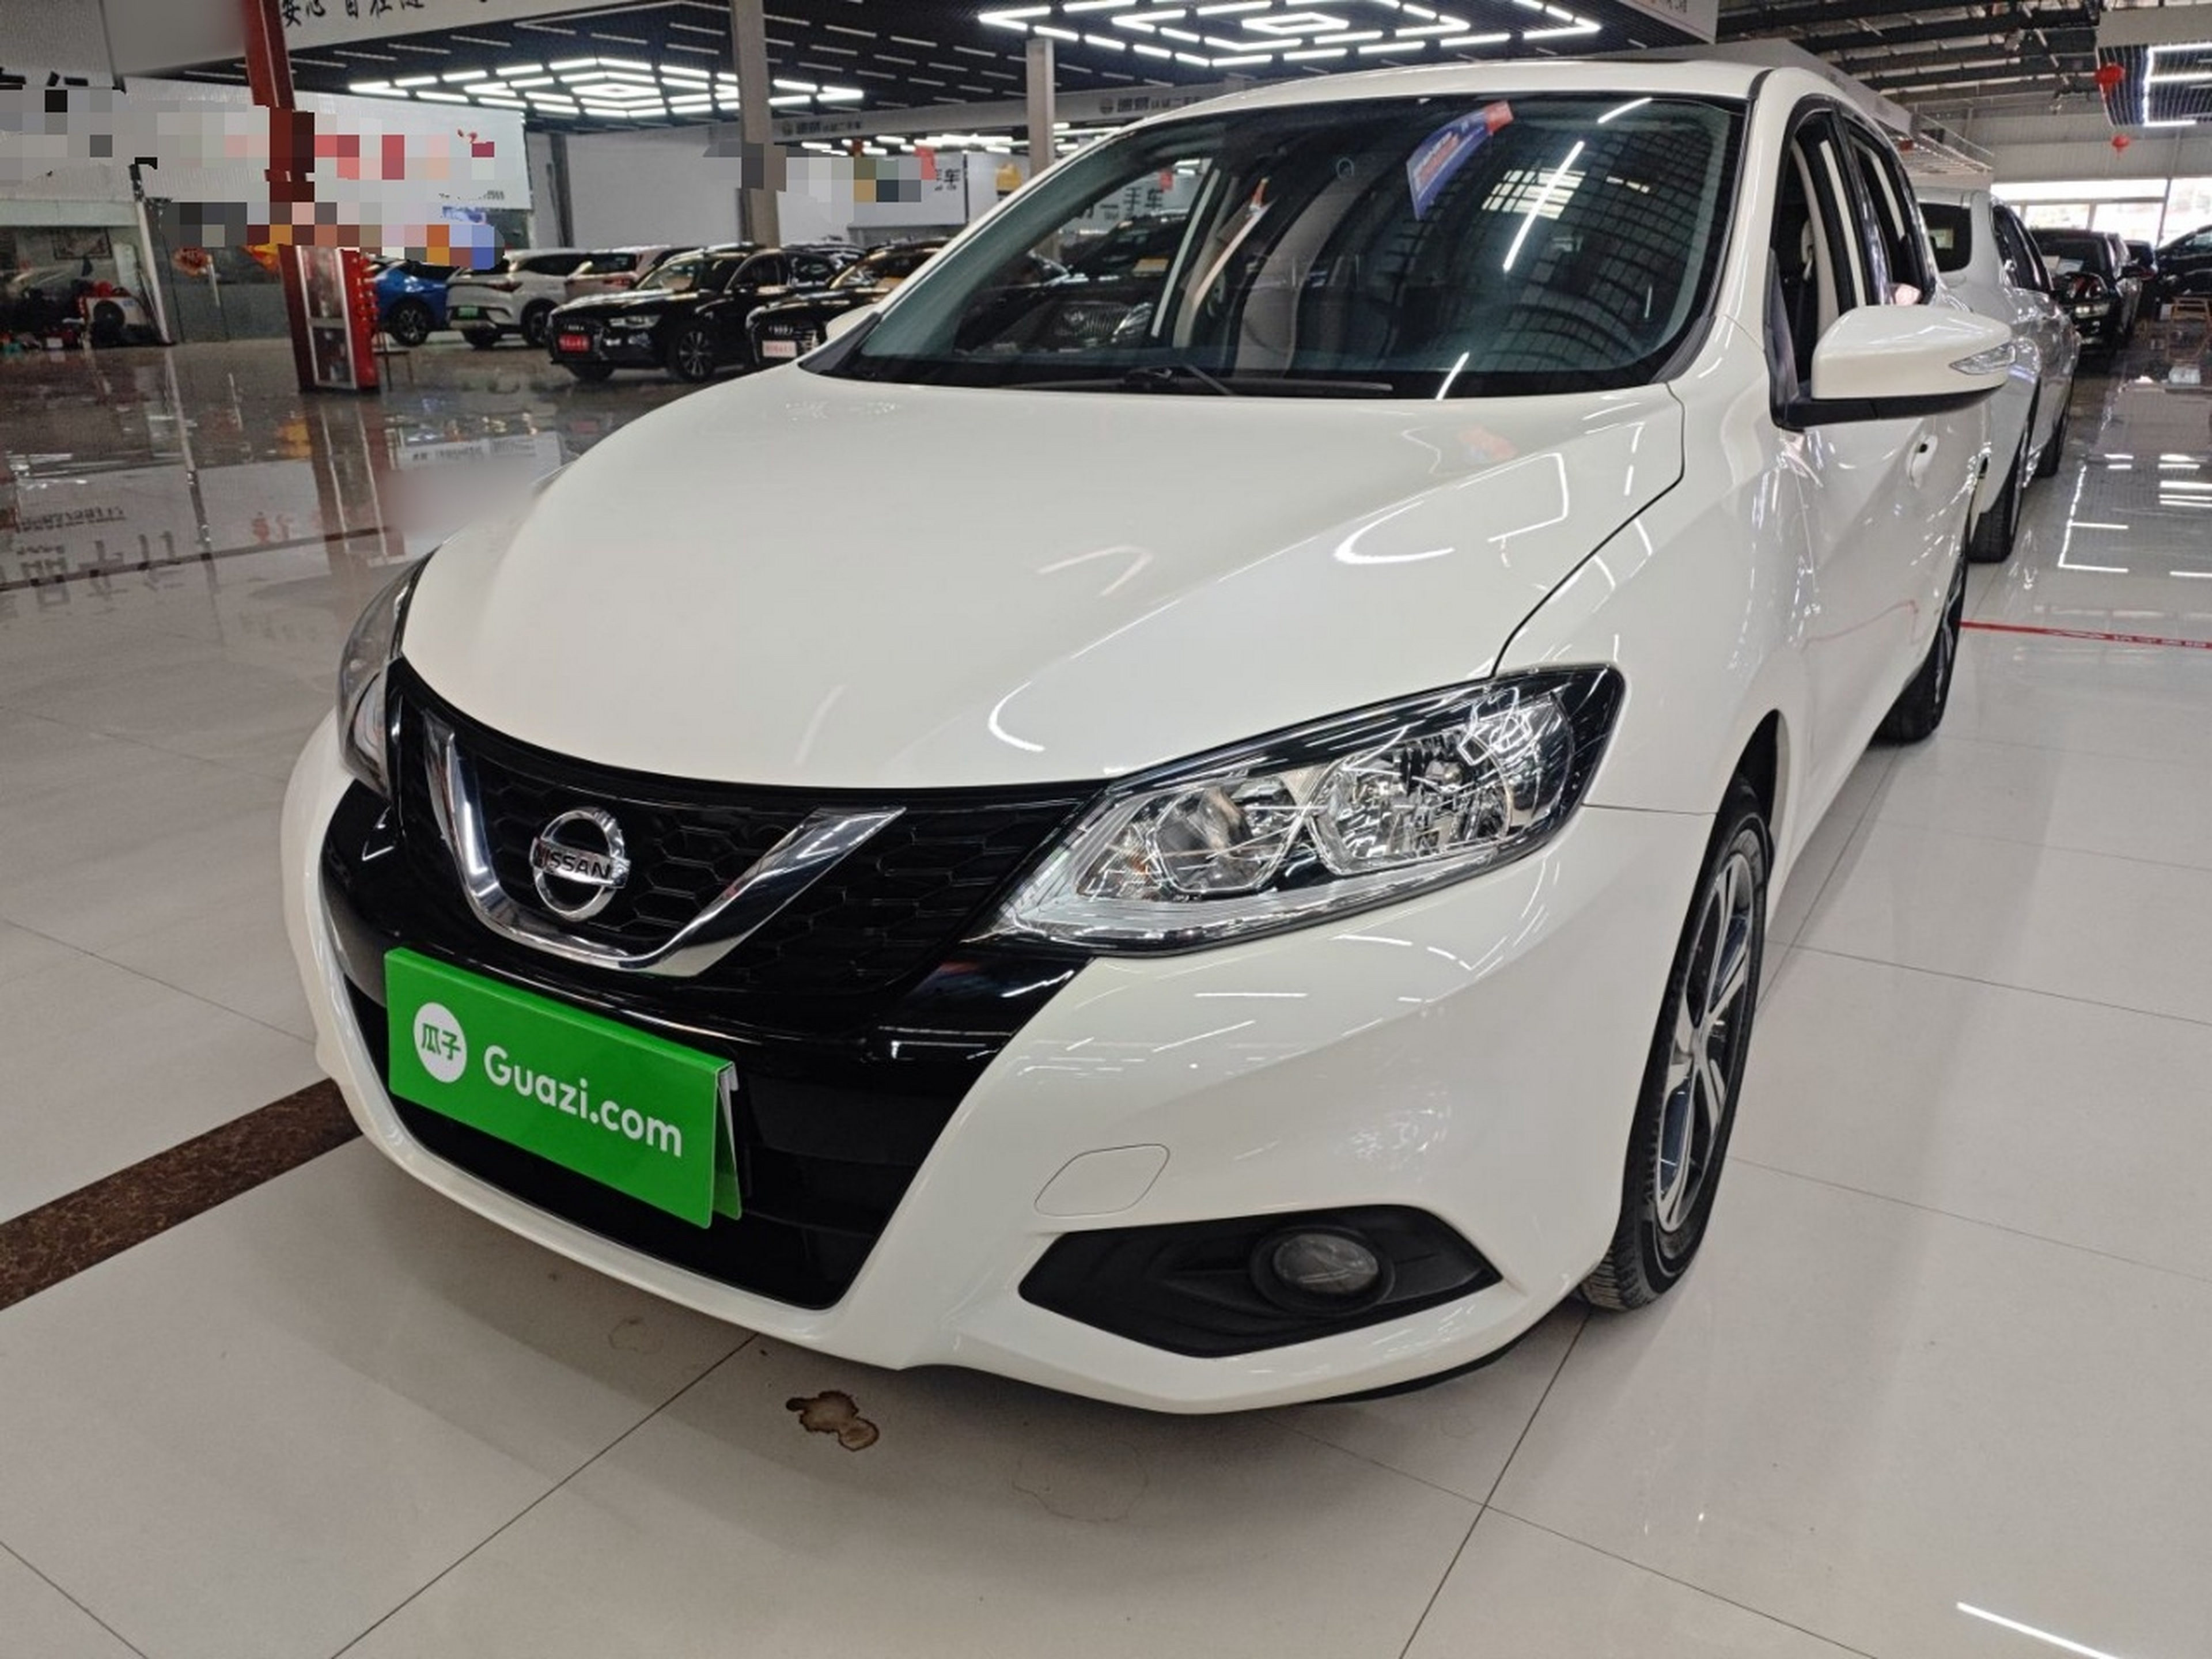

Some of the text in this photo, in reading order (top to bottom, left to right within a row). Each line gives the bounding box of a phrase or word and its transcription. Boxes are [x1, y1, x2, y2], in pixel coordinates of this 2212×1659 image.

[536, 843, 611, 879] NISSAN
[422, 1024, 460, 1061] 瓜子
[484, 1045, 682, 1158] Guazi.com
